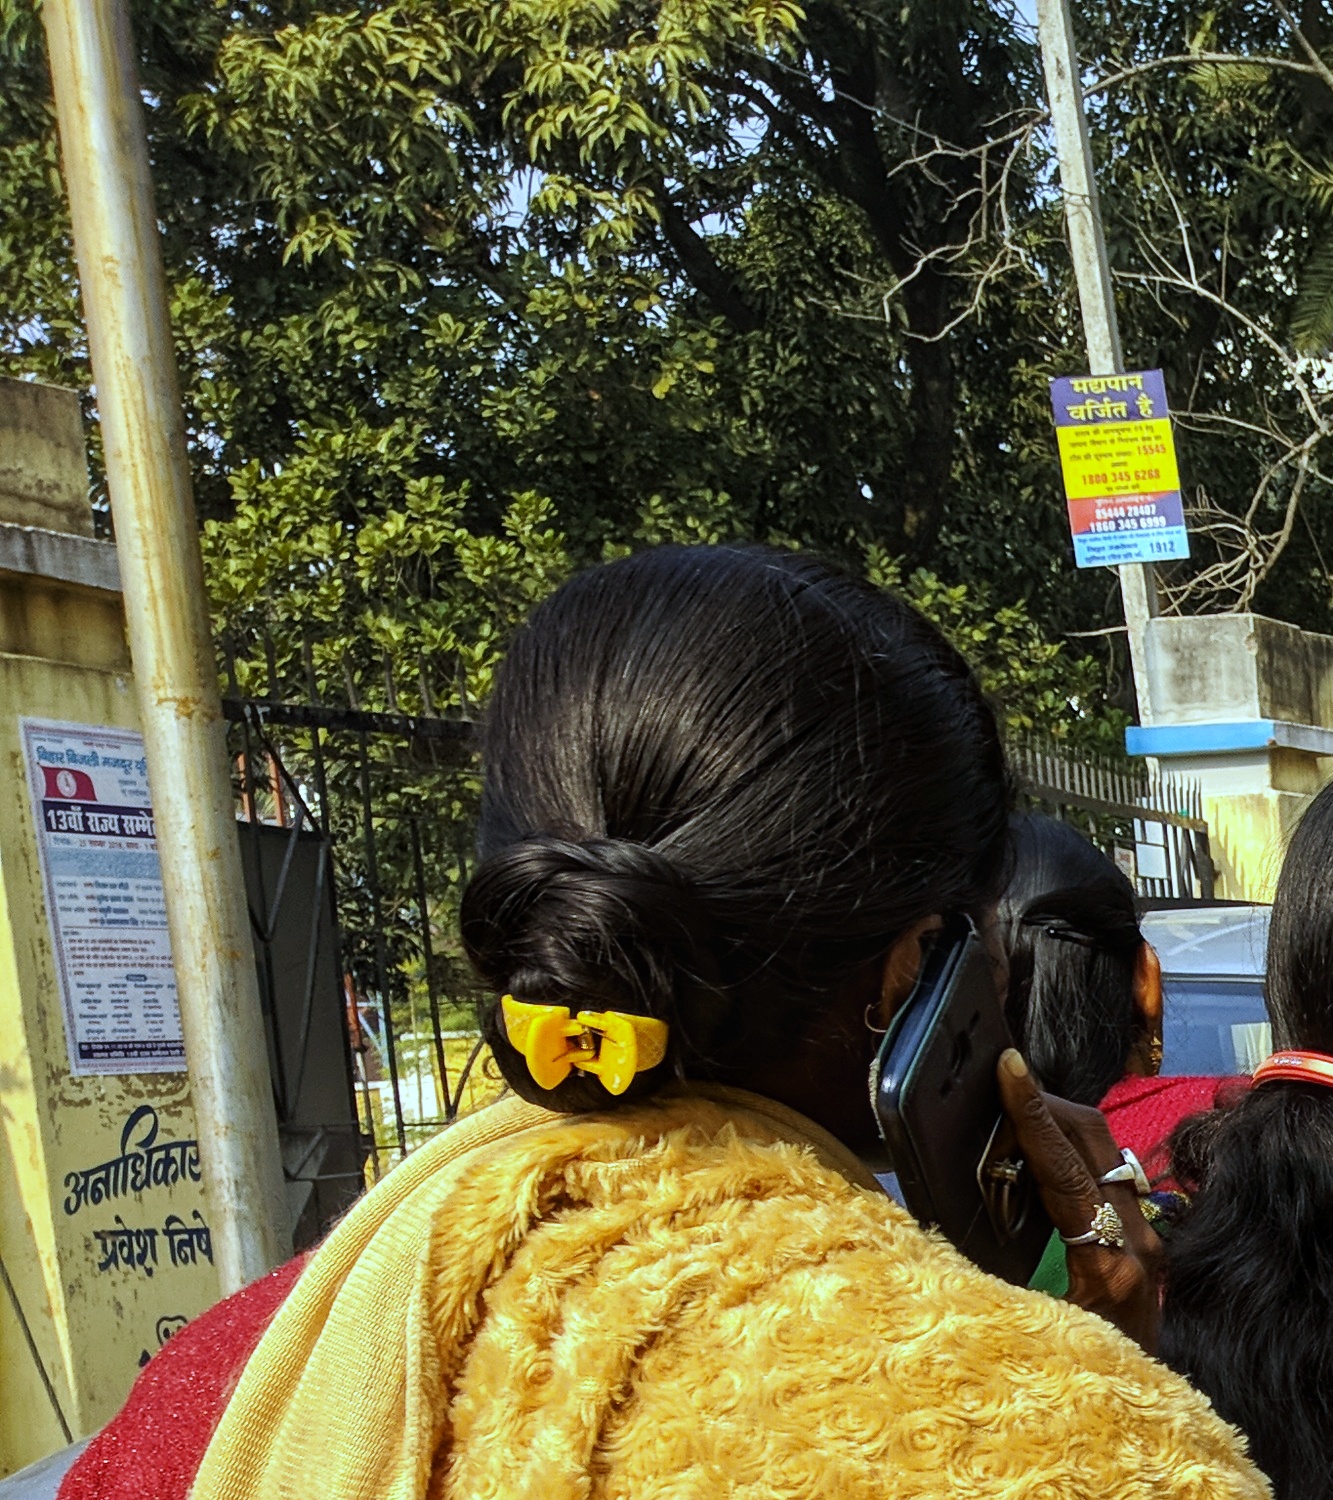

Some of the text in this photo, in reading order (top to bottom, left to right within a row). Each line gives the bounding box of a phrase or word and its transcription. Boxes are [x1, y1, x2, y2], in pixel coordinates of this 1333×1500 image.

[1070, 375, 1143, 394] मद्यपान
[1066, 392, 1154, 421] वर्जित है
[1082, 472, 1108, 485] 1800
[1111, 470, 1131, 483] 345
[1118, 518, 1138, 530] 345
[1150, 541, 1175, 553] 1912
[85, 811, 120, 834] राज्य
[93, 1209, 215, 1278] प्रवेश निषे
